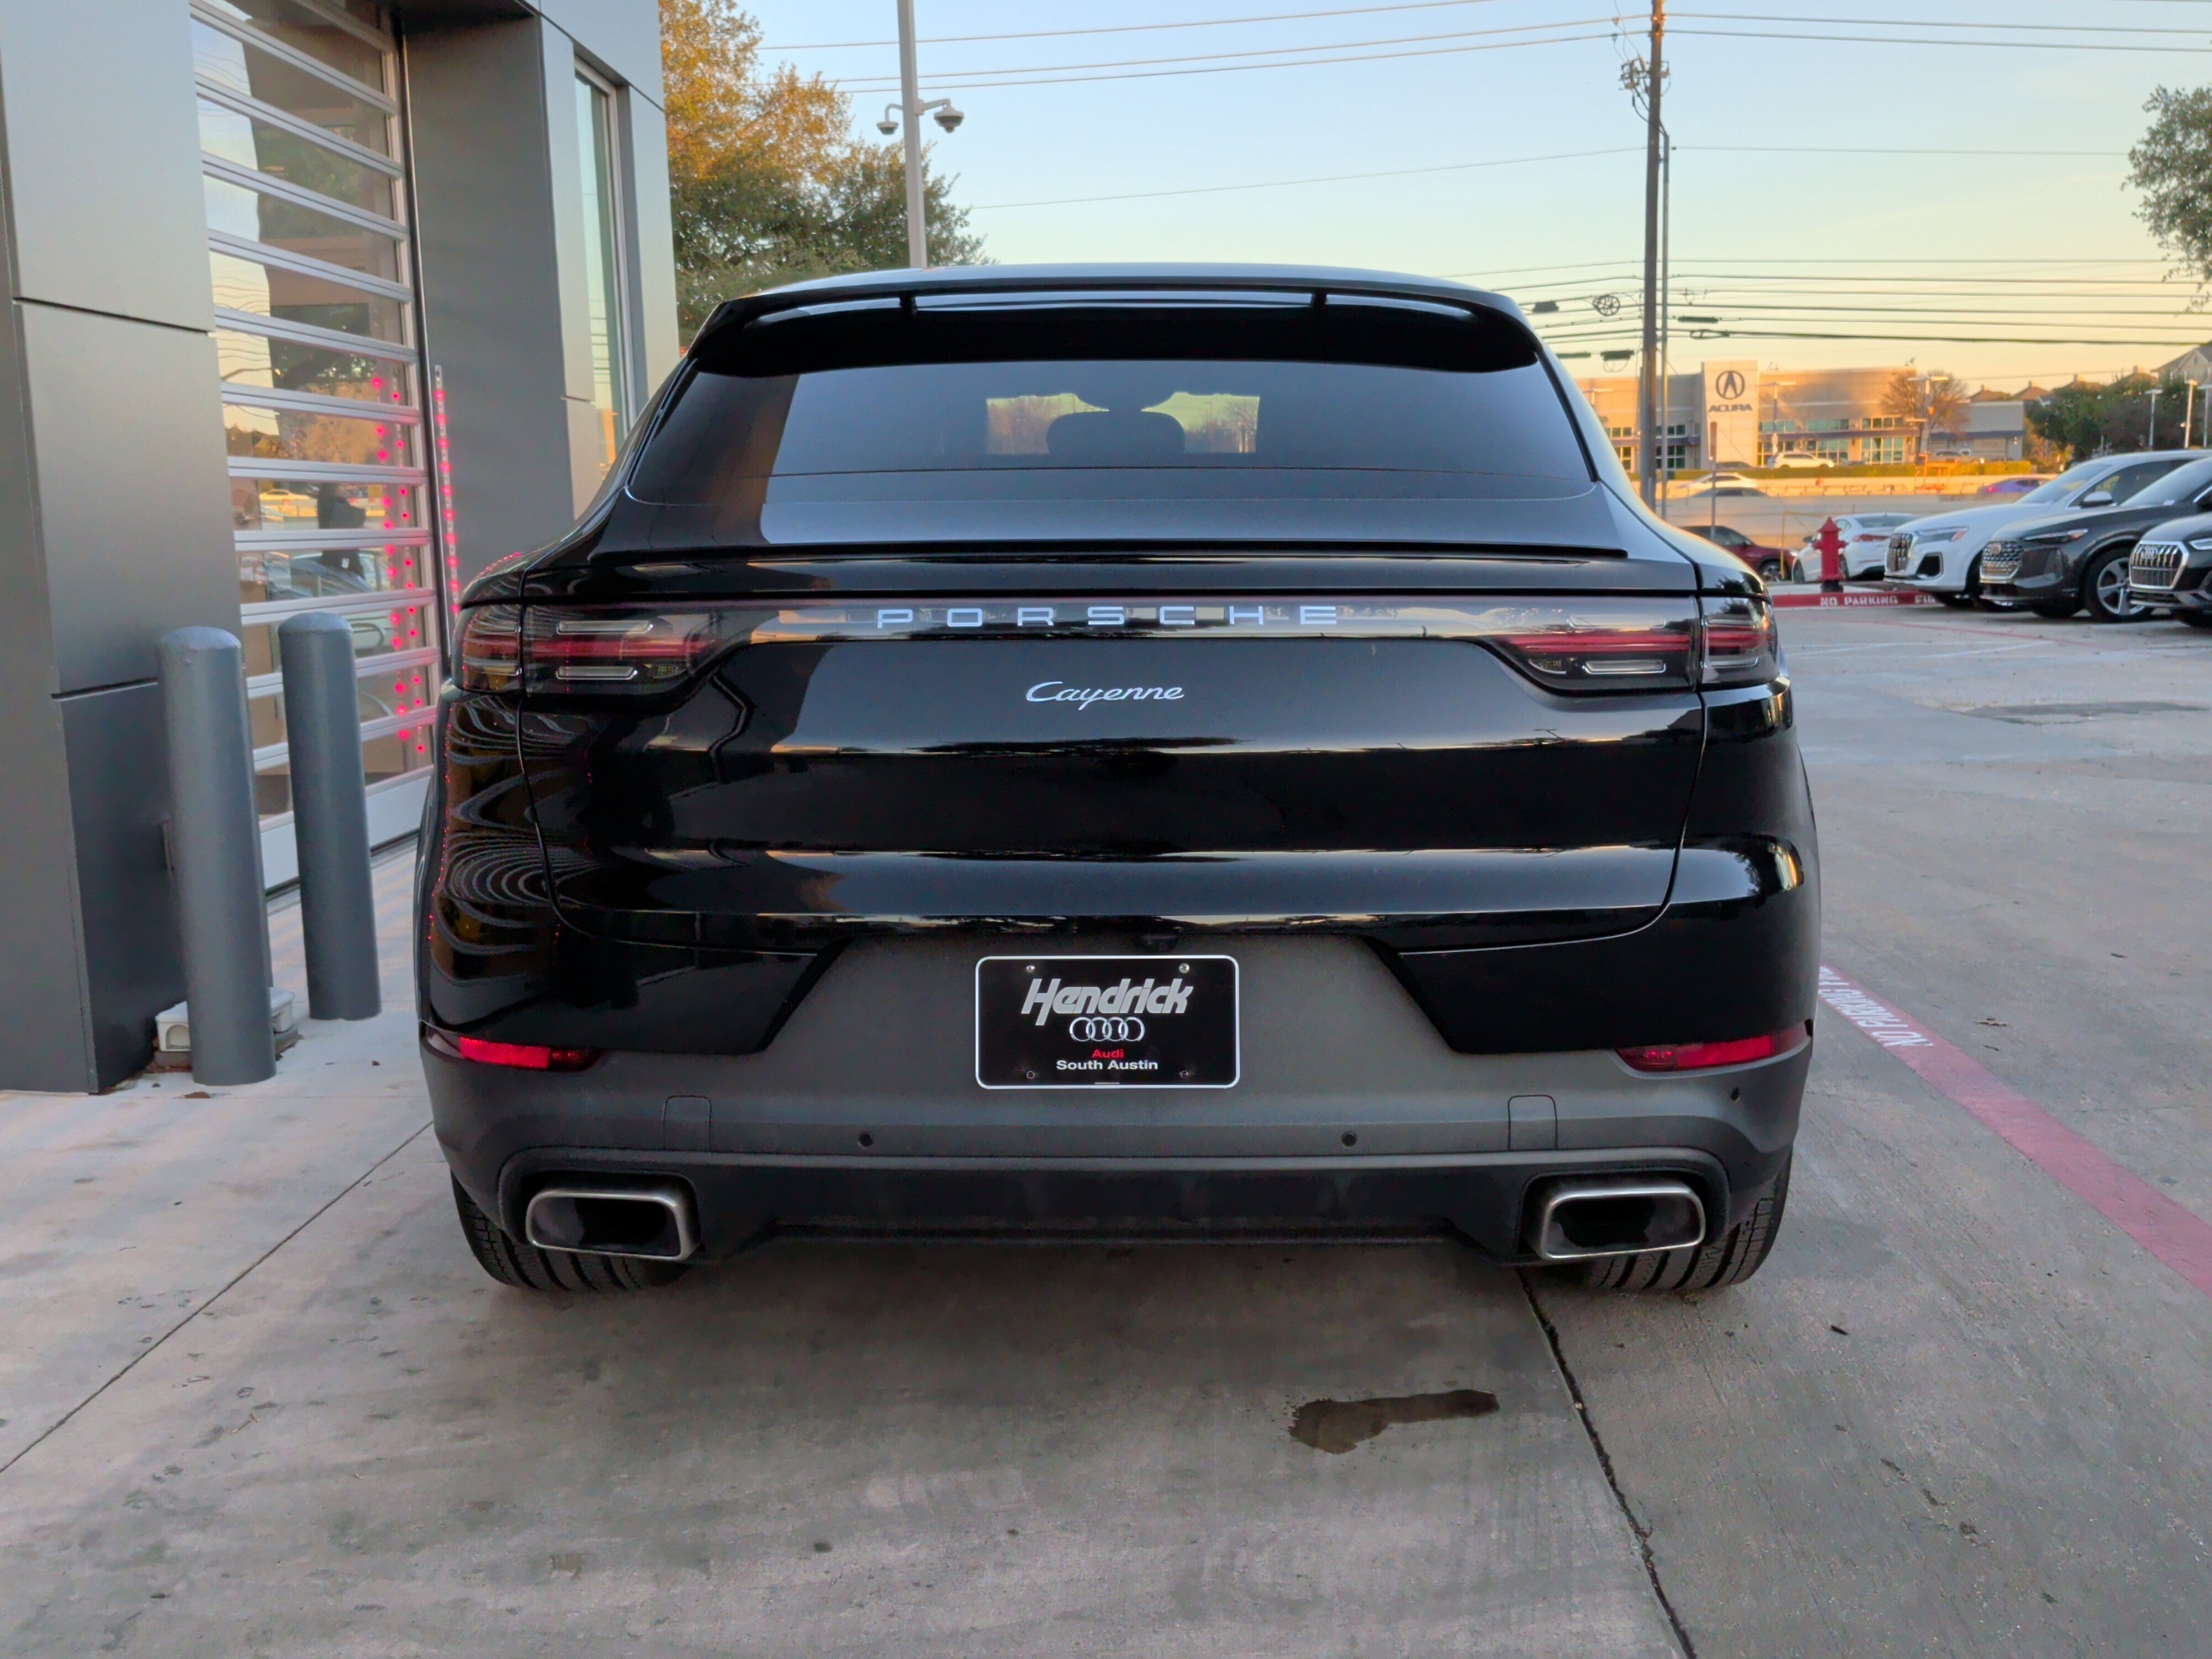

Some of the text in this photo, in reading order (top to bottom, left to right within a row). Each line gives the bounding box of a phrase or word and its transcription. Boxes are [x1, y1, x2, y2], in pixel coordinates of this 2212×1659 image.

[1708, 404, 1753, 413] ACURA
[1820, 596, 1838, 606] NO
[1844, 595, 1898, 605] PARKING
[877, 605, 1337, 629] PORSCHE
[1025, 681, 1185, 711] Cayenne
[1020, 978, 1194, 1026] Hendrick
[1817, 989, 1934, 1047] NO PARKING
[1092, 1048, 1124, 1059] Audi
[1056, 1060, 1158, 1070] South Austin
